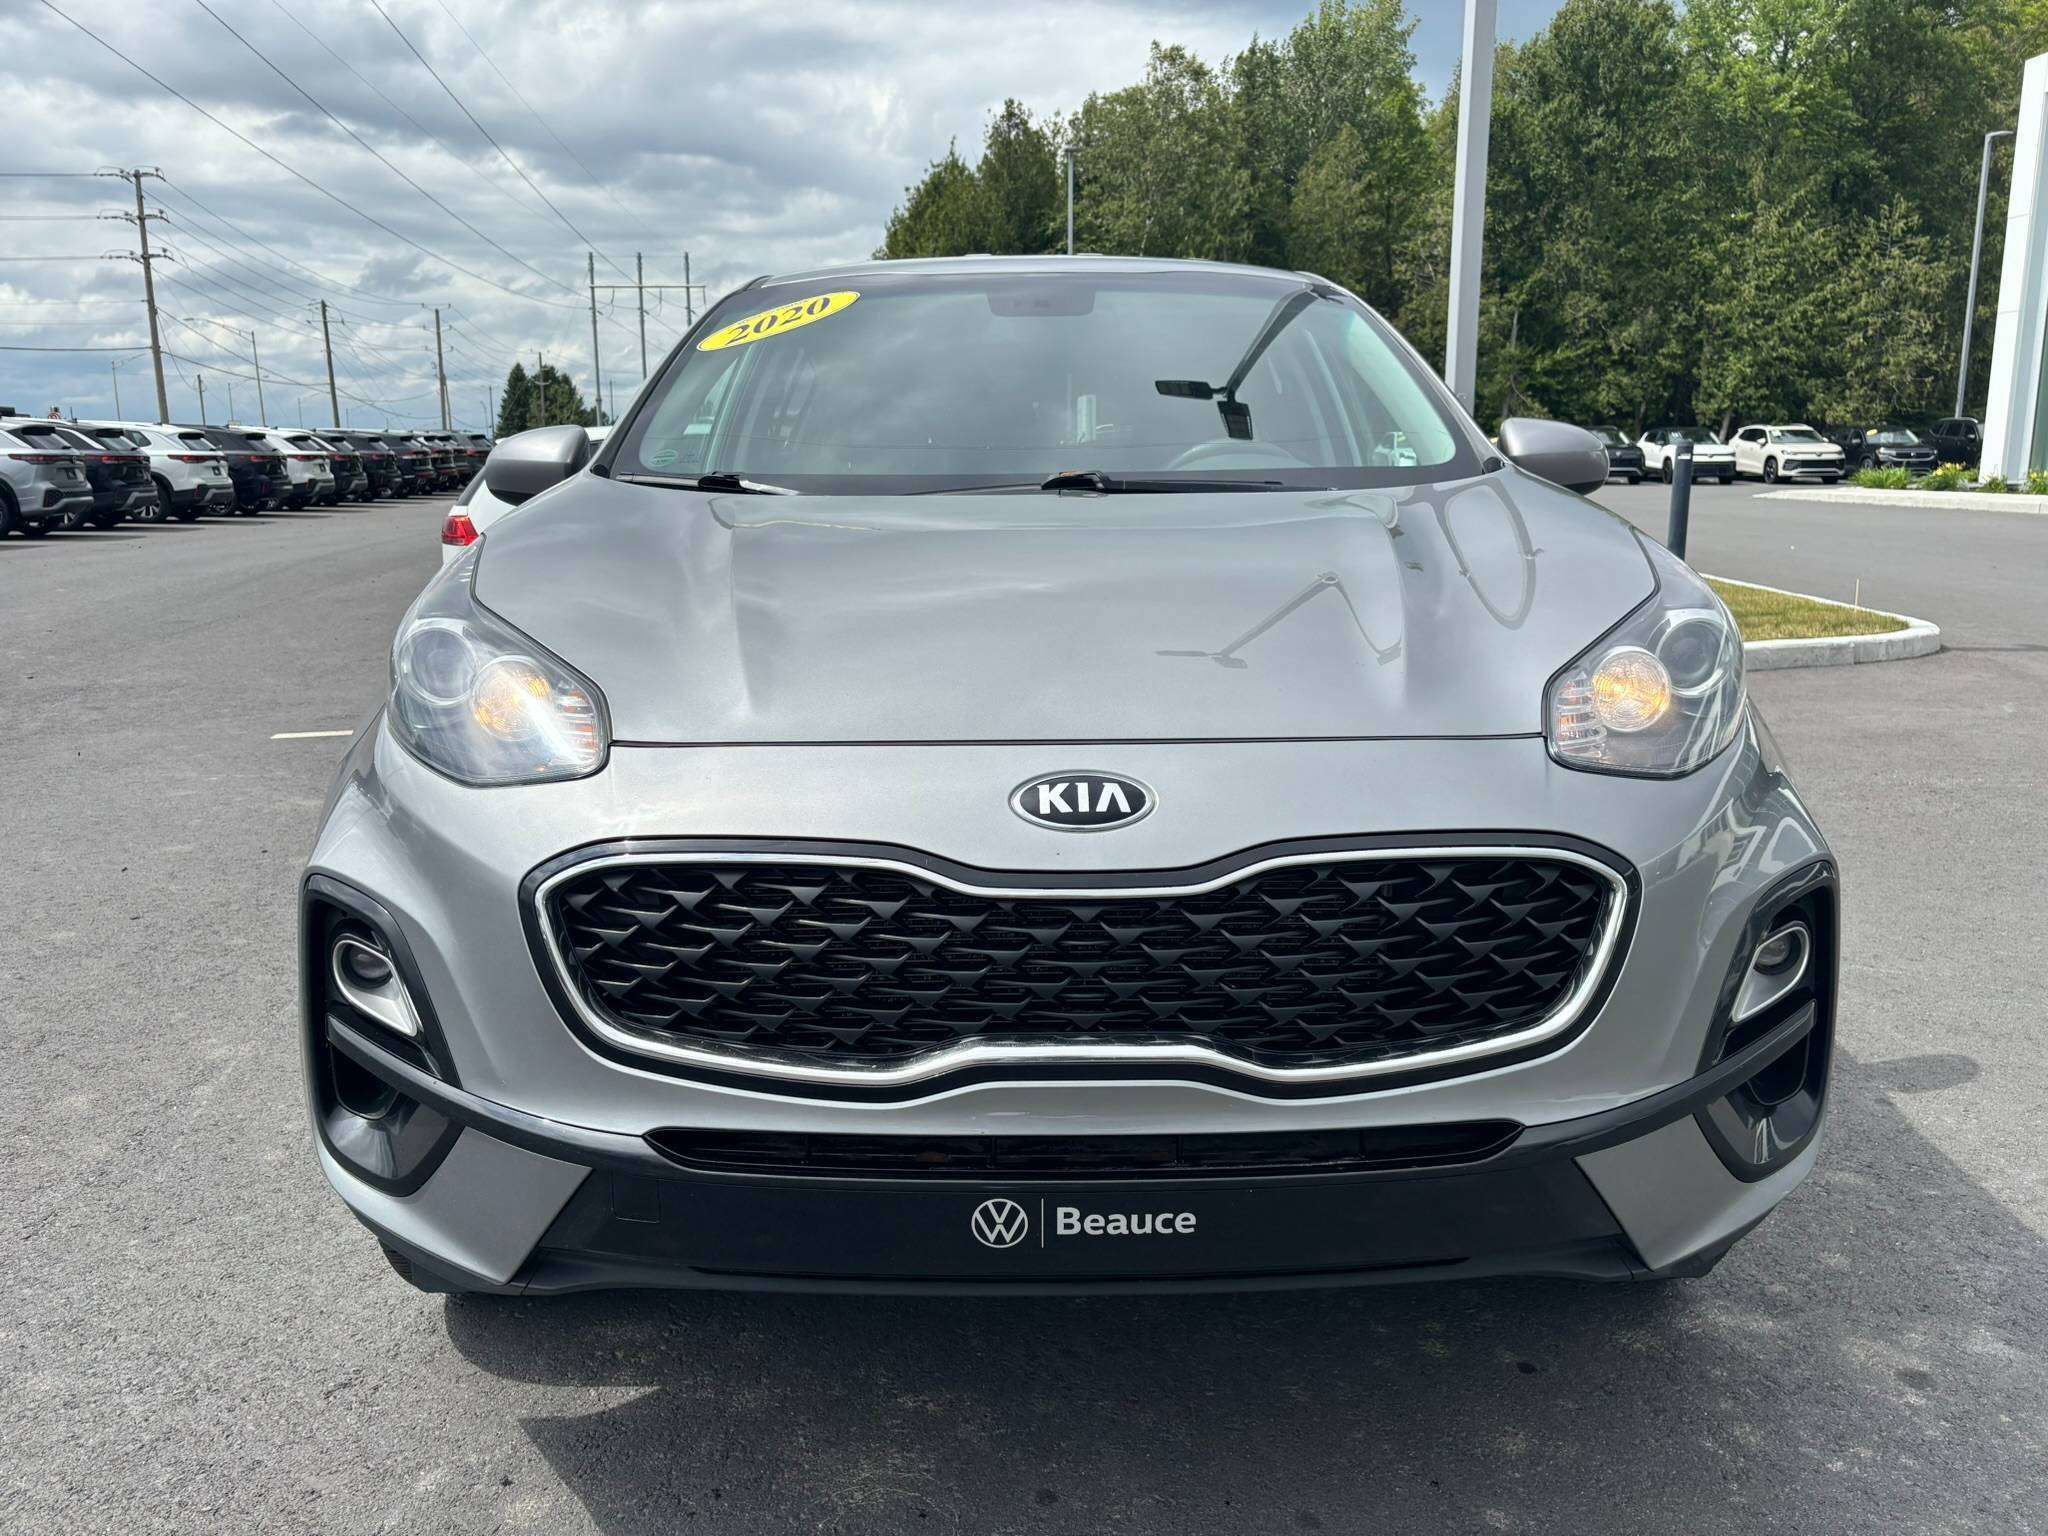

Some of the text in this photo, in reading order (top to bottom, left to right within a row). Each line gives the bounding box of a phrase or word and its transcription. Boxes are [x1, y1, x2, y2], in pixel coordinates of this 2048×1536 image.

[725, 297, 830, 344] 2020
[1037, 782, 1131, 814] KIA
[971, 1198, 1196, 1248] VW Beauce
